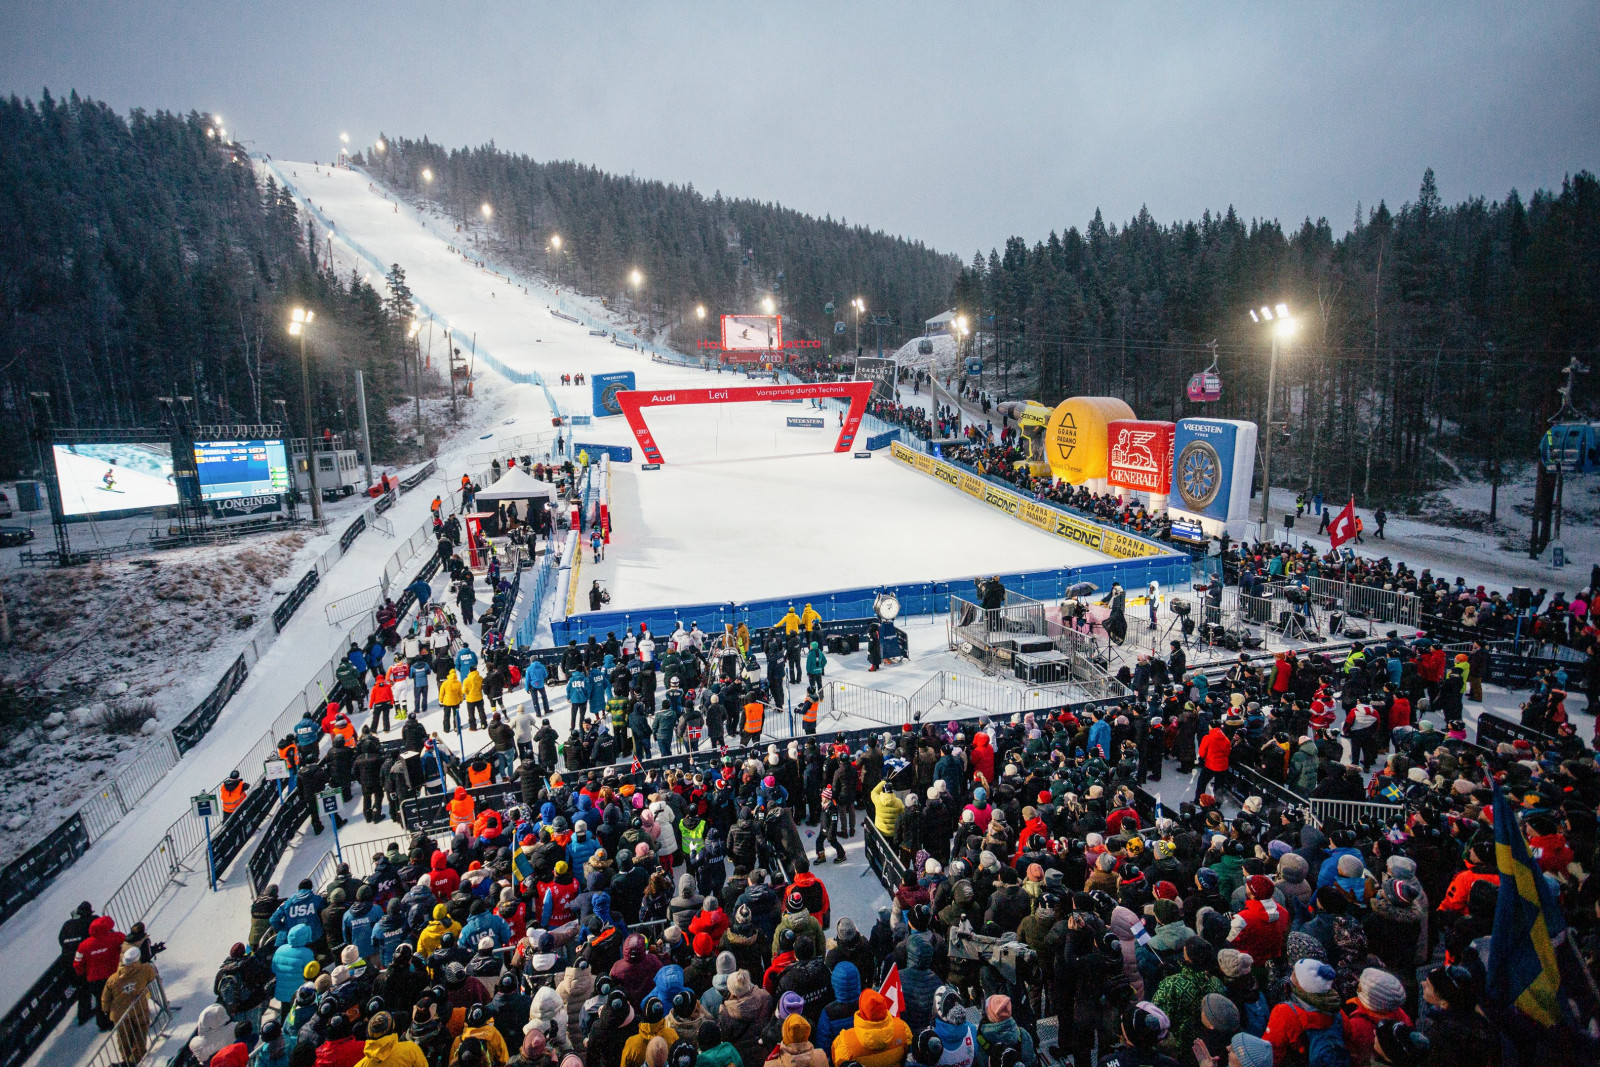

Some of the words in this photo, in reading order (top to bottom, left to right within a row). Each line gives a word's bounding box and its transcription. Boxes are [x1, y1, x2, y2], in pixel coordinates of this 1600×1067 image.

[697, 338, 718, 349] Ho
[783, 338, 821, 349] attro
[708, 390, 729, 400] Levi
[756, 387, 794, 396] Vorsprung
[796, 386, 817, 394] durch
[818, 386, 845, 394] Technik
[651, 394, 676, 402] Audi
[1057, 428, 1077, 437] GRANA
[1183, 423, 1223, 434] VREDESTEIN
[1056, 436, 1077, 445] PADANO
[895, 449, 914, 465] ZGONC
[934, 467, 958, 485] ZGONC
[966, 476, 981, 487] GRANA
[1110, 468, 1158, 487] GENERALI
[216, 496, 277, 510] LONGINES
[985, 492, 1017, 514] ZGONC
[1027, 503, 1048, 517] GRANA
[1026, 511, 1047, 525] PADANO
[1056, 522, 1100, 548] ZGONC
[1116, 535, 1145, 553] GRANA
[629, 667, 640, 675] USA
[571, 680, 585, 688] USA
[435, 878, 448, 886] GBR
[289, 902, 315, 918] USA
